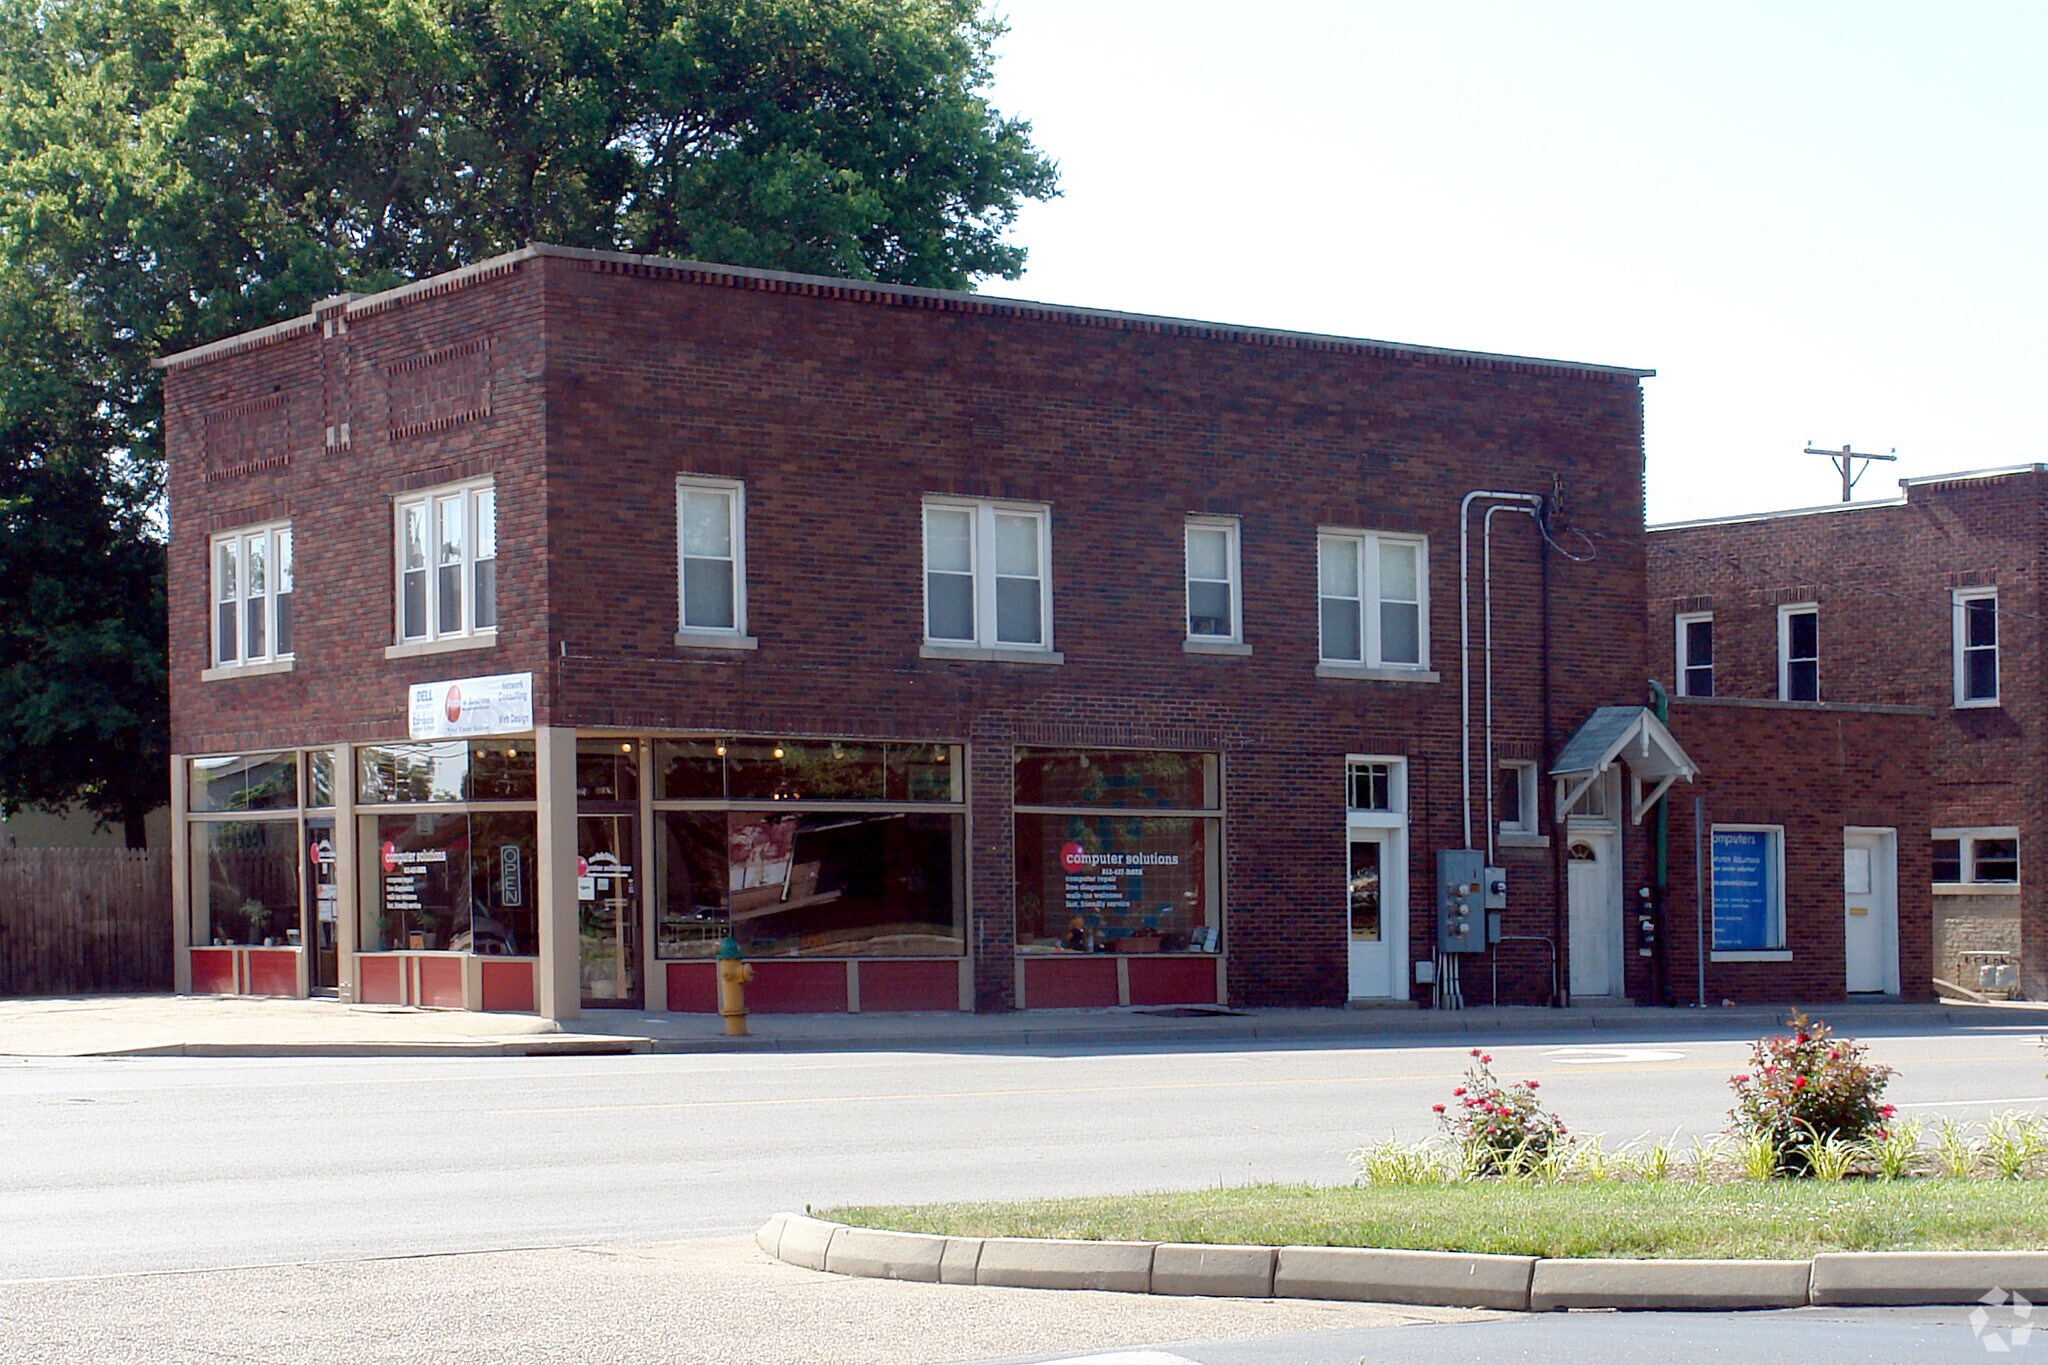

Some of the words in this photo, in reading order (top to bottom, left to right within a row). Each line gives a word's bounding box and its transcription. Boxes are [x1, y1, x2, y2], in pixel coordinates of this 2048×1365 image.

[416, 690, 433, 702] DELL
[385, 852, 415, 864] computer
[416, 848, 447, 862] solutions
[1066, 854, 1123, 866] computer
[1125, 852, 1179, 865] solutions
[503, 848, 518, 903] OPEN
